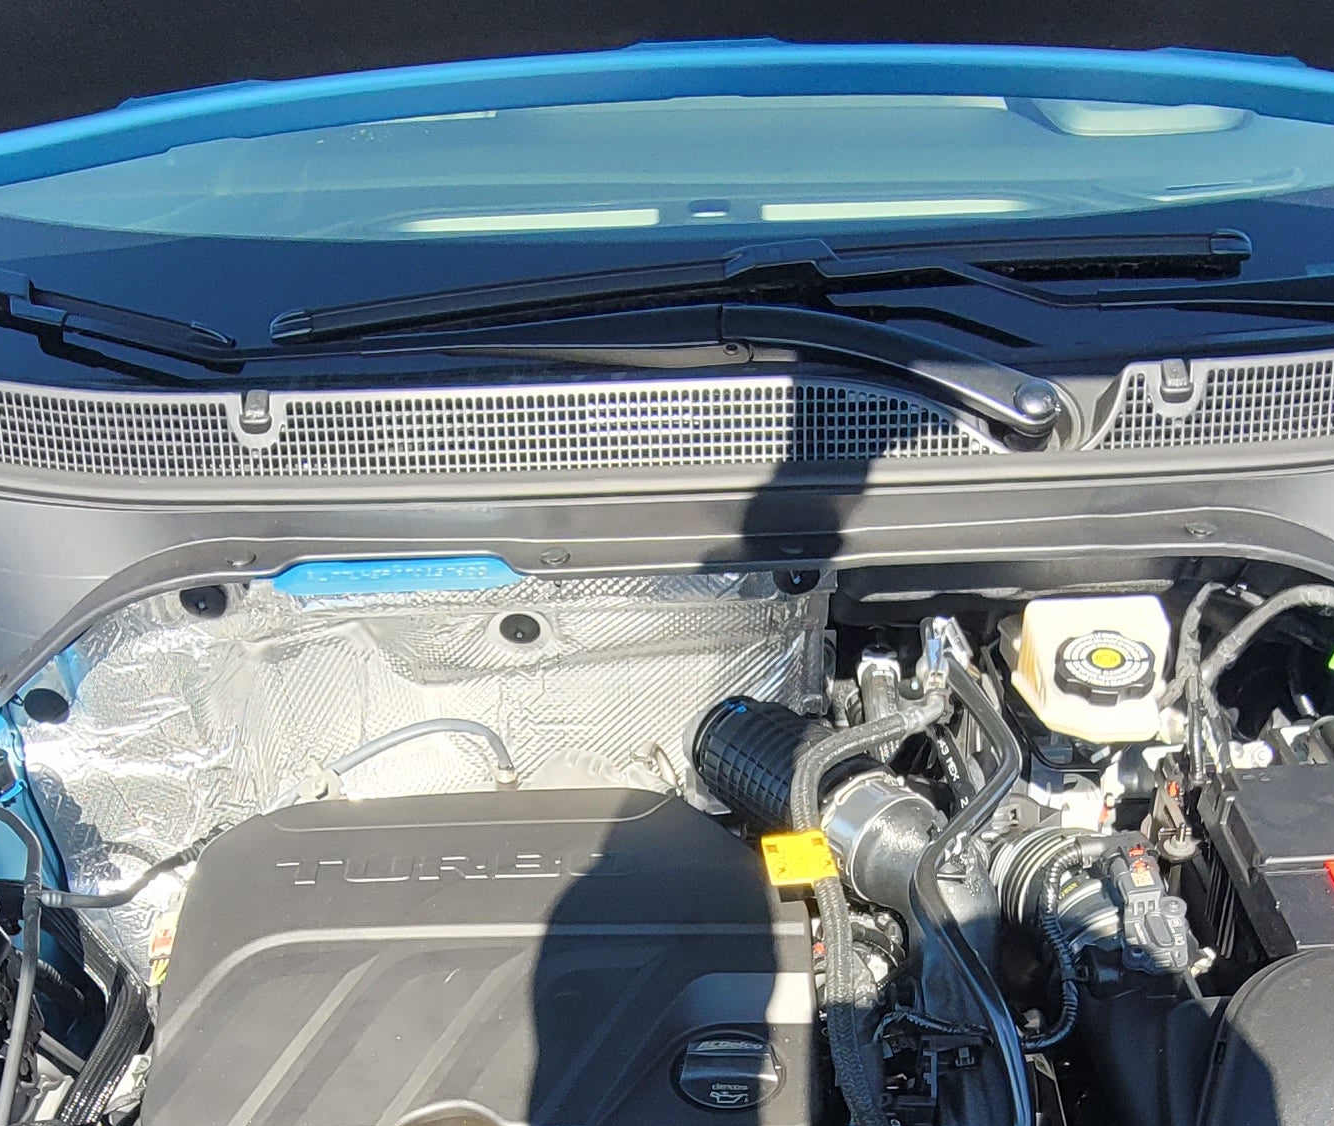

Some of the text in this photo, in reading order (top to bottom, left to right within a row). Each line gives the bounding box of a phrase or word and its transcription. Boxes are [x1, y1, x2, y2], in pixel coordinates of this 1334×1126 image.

[275, 853, 636, 885] TURBO
[696, 1041, 764, 1052] ACDelco
[711, 1083, 749, 1091] dexos
